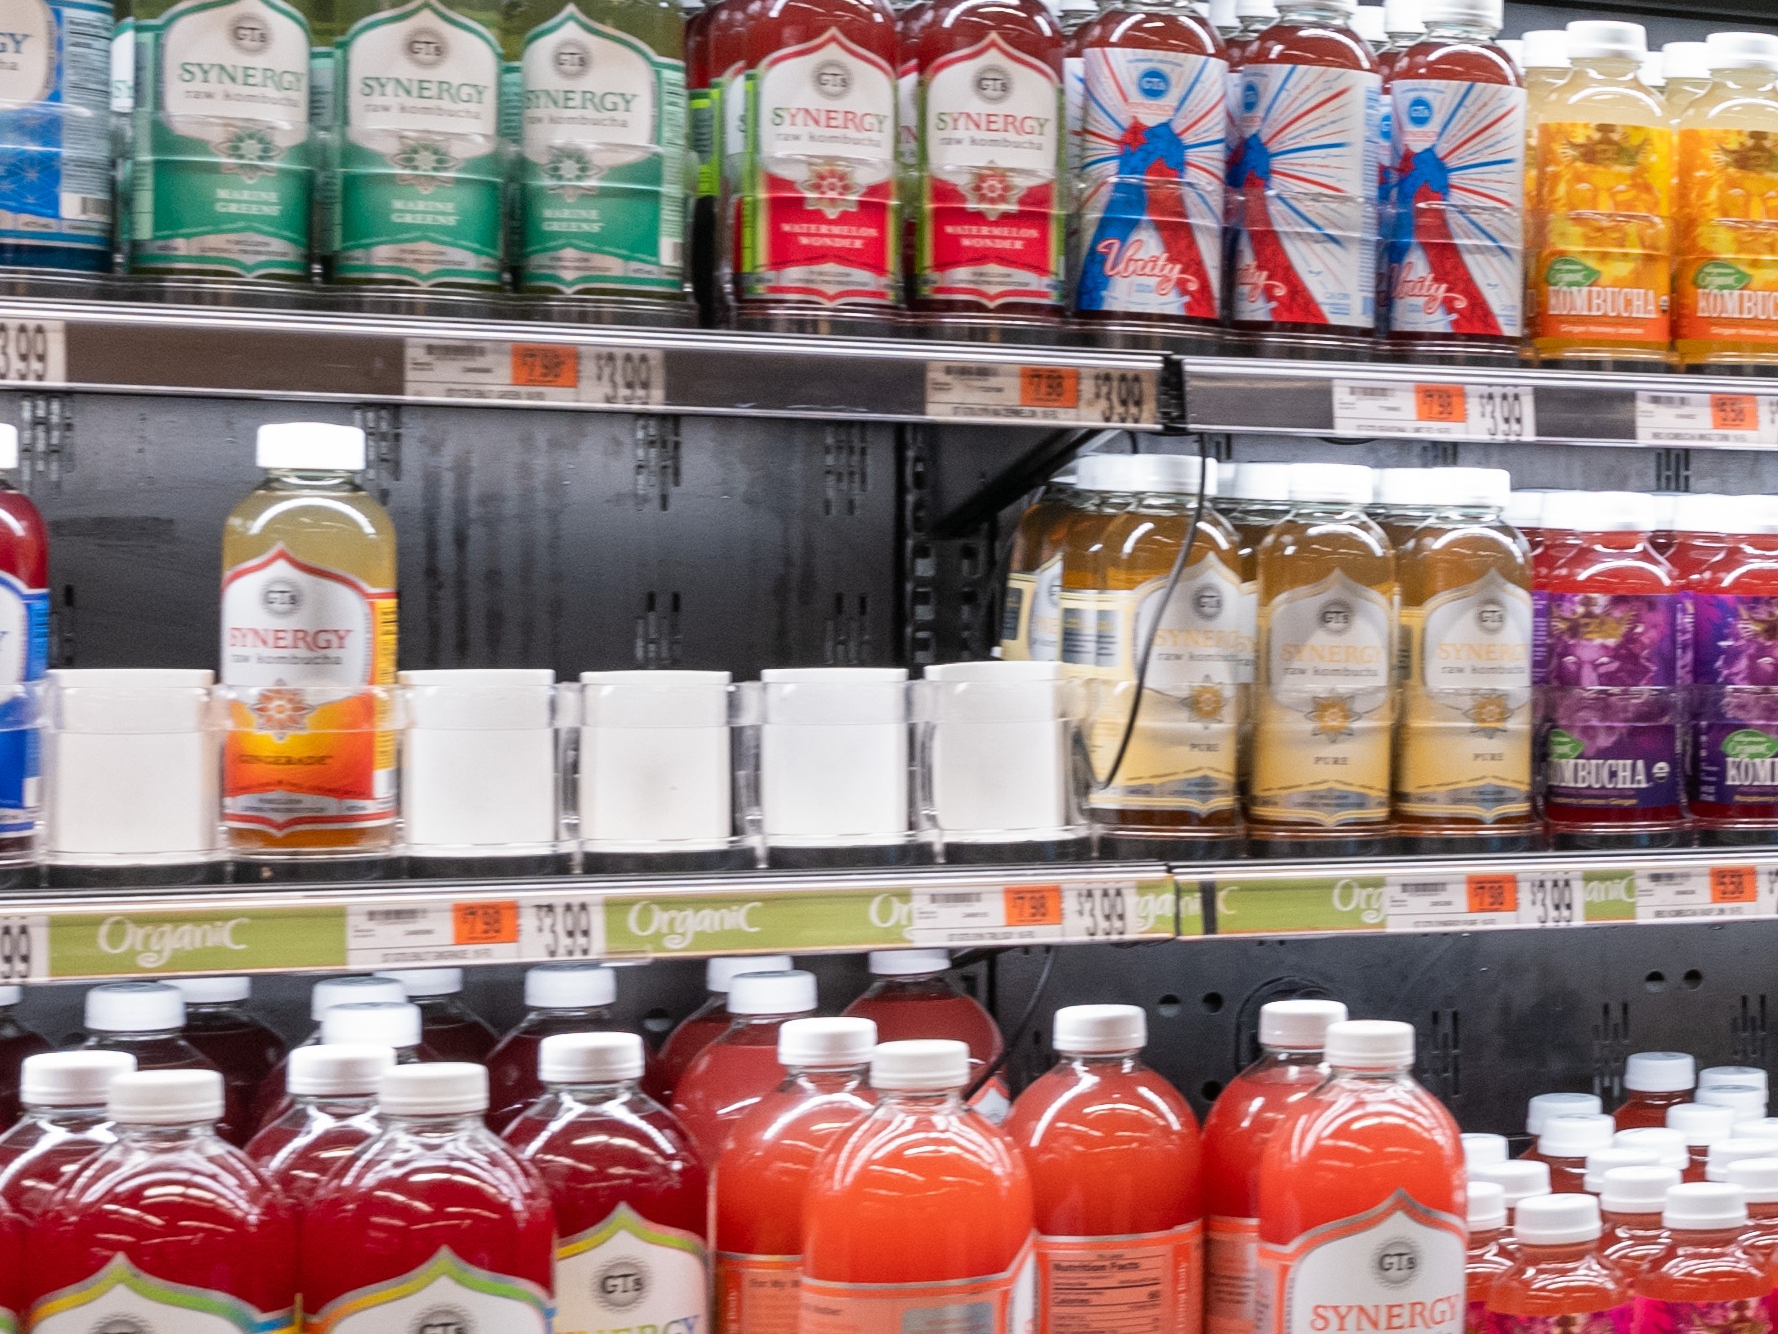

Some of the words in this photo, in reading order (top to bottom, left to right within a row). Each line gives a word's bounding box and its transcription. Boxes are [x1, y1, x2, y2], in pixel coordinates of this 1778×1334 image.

[178, 62, 303, 93] SYNERGY
[361, 78, 488, 106] SYNERGY
[524, 89, 639, 114] SYNERGY
[399, 99, 481, 122] kombucha
[772, 108, 888, 133] SYNERGY
[936, 109, 1050, 135] SYNERGY
[781, 222, 879, 240] WATERMELON
[799, 234, 863, 250] WONDER
[1097, 236, 1198, 292] Unity
[1547, 287, 1658, 318] KOMBUCHA
[230, 628, 351, 651] SYNERGY
[98, 915, 250, 967] Organic
[628, 901, 762, 954] Organic
[1311, 1297, 1459, 1332] SYNERGY
